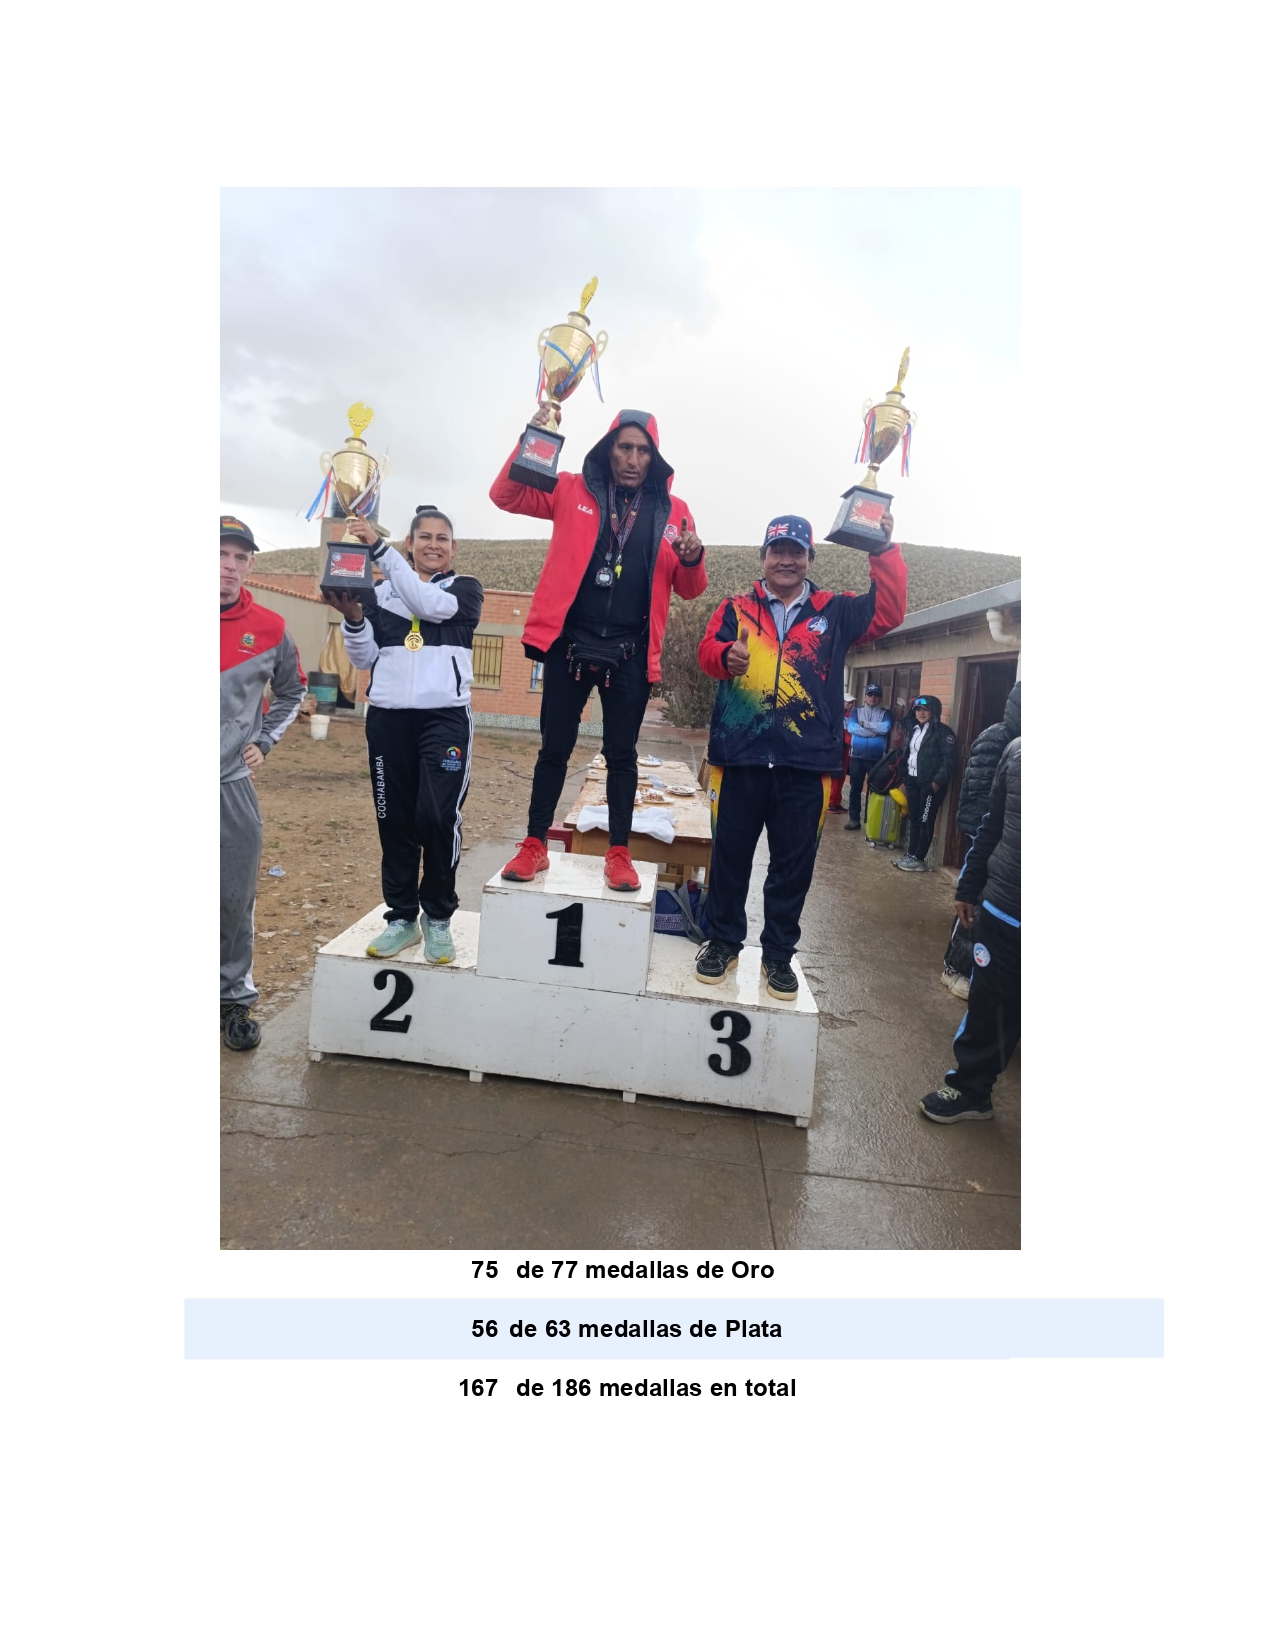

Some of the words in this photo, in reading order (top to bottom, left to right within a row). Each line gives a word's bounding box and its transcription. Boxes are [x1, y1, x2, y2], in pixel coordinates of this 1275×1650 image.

[375, 755, 387, 819] COCHABAMBA
[546, 903, 584, 968] 1
[369, 969, 413, 1034] 2
[708, 1010, 752, 1077] 3
